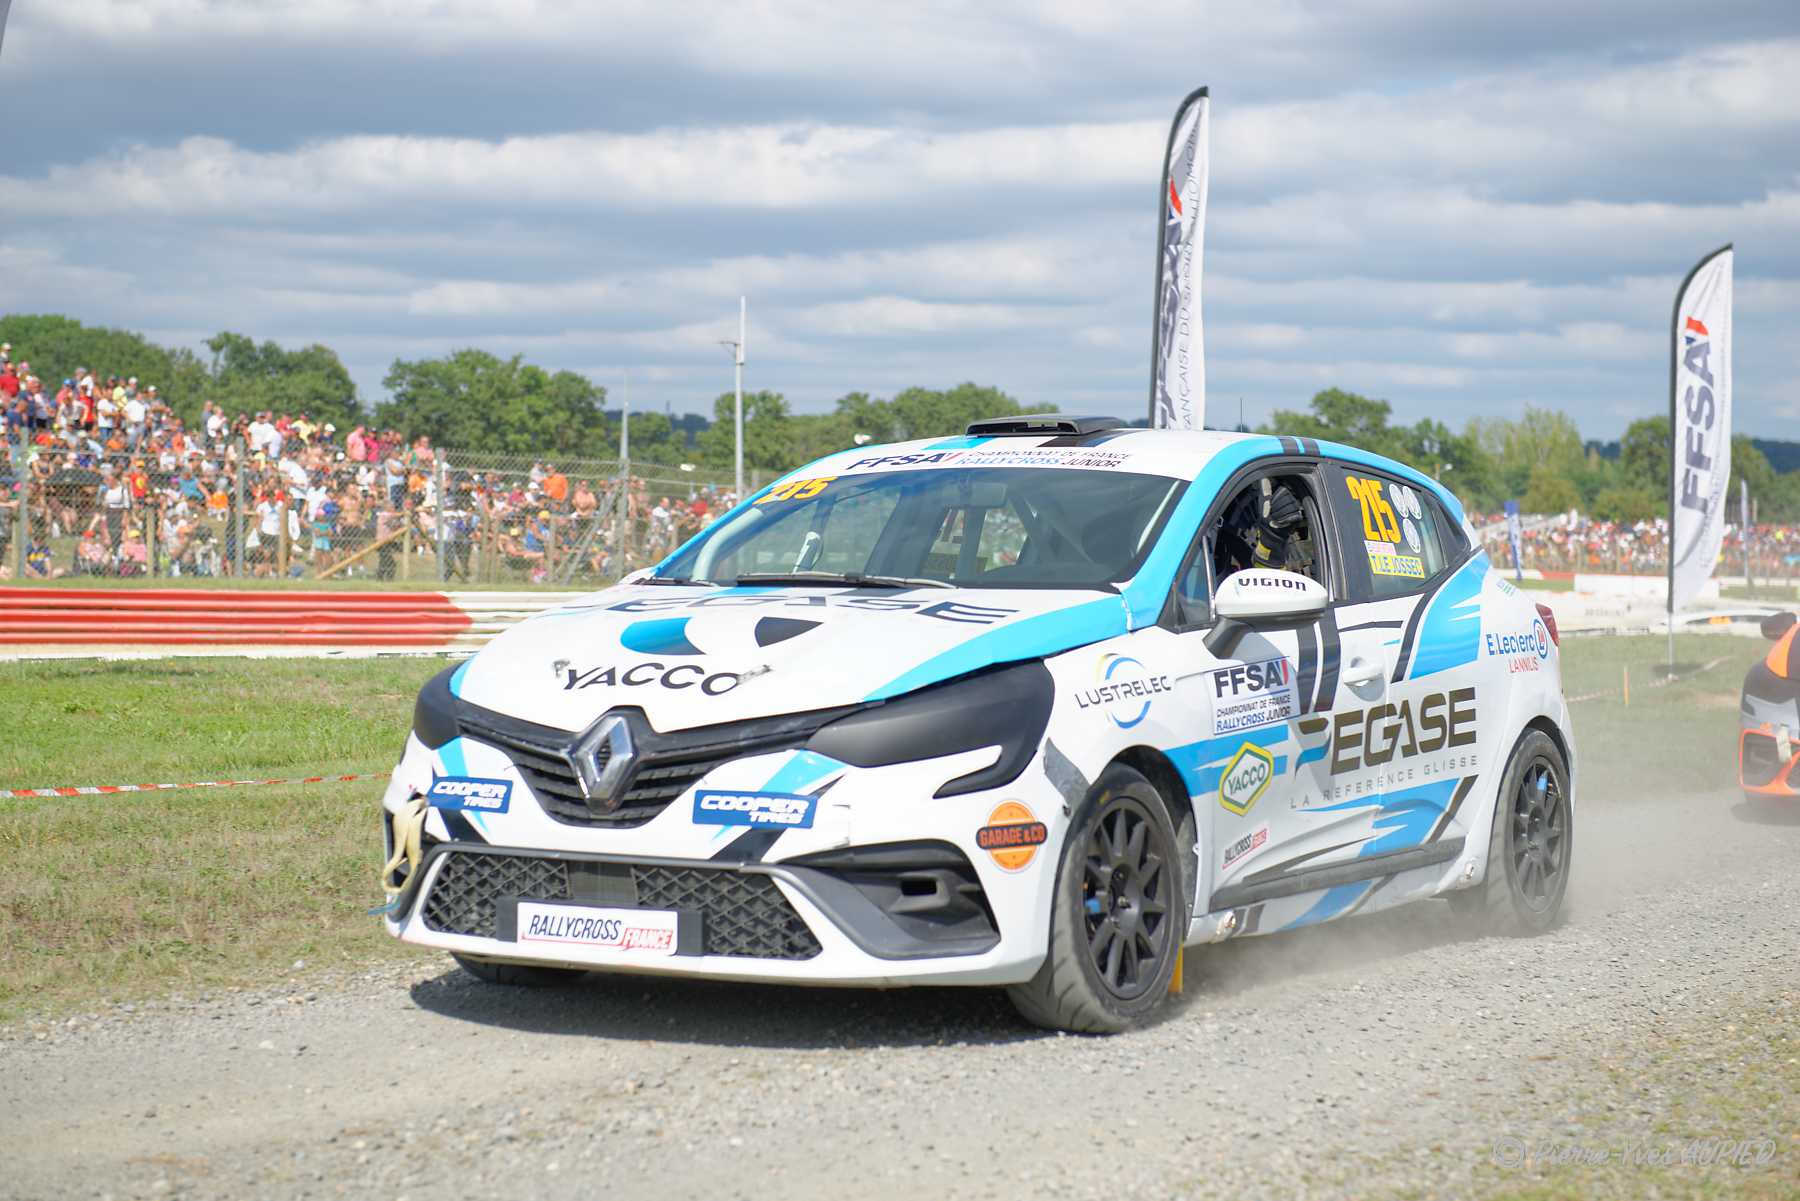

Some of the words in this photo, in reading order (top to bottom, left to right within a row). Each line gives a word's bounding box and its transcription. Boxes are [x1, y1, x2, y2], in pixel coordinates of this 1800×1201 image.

[1682, 341, 1715, 514] FFSA
[846, 453, 947, 470] FFSA
[1060, 459, 1123, 468] JUNIOR
[752, 476, 838, 504] 215
[1345, 476, 1401, 543] 215
[563, 662, 740, 696] YACCO
[1074, 676, 1172, 709] LUSTRELEC
[1213, 661, 1283, 698] FFSA
[1216, 701, 1258, 718] CHAMPIONNAT
[1259, 699, 1268, 709] DE
[1216, 712, 1265, 732] RALLYCROSS
[1265, 706, 1292, 721] JUNIOR
[1295, 687, 1477, 777] PEGASE
[433, 781, 507, 798] COOPER
[1228, 763, 1265, 795] YACCO
[1290, 794, 1310, 809] LA
[1324, 769, 1414, 800] REFERENCE
[1424, 755, 1478, 775] GLISSE
[463, 795, 503, 808] TIRES
[701, 795, 810, 814] COOPER
[749, 811, 804, 824] TIRES
[528, 914, 622, 941] RALLYCROSS
[624, 927, 674, 949] FRANCE
